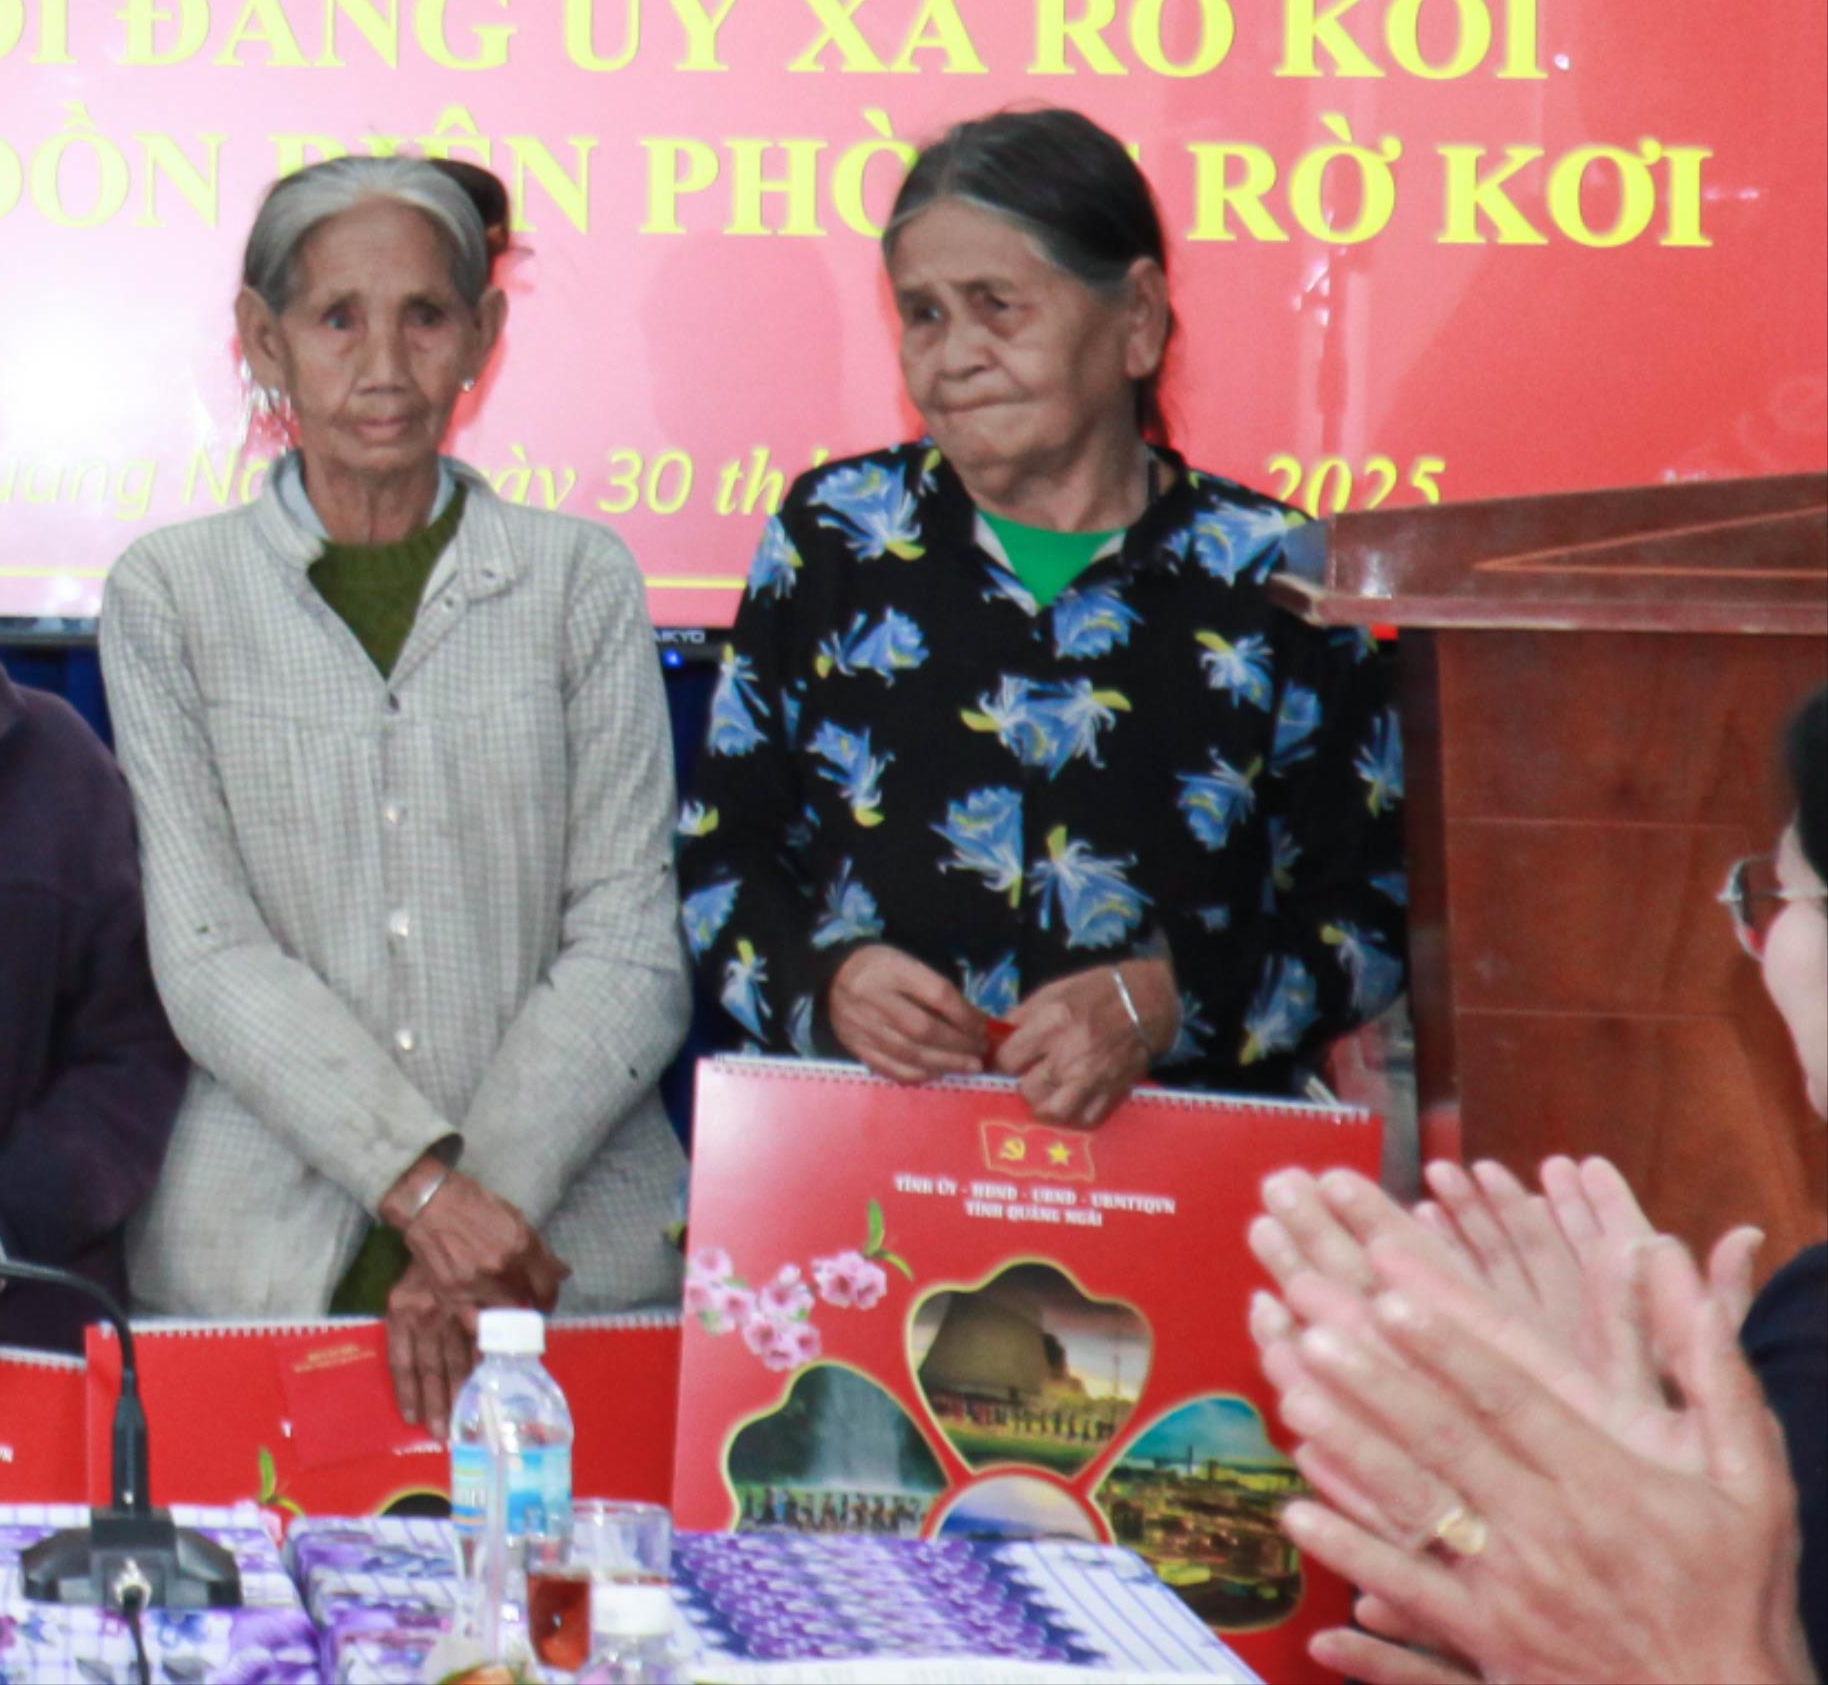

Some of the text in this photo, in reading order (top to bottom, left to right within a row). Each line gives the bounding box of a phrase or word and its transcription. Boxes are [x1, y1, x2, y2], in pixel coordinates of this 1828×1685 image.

[1186, 113, 1402, 245] RỜ
[1436, 137, 1715, 248] KƠI
[598, 447, 694, 515] 30
[1267, 454, 1446, 520] 2025
